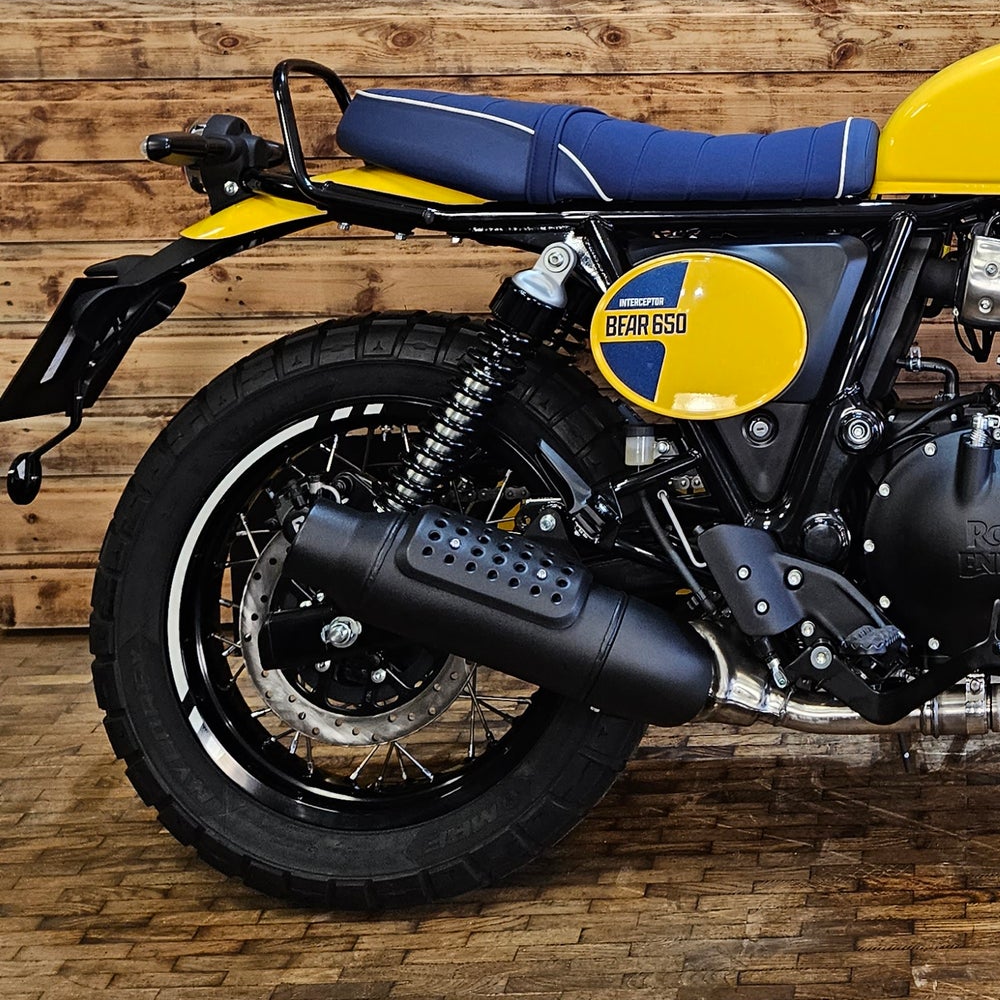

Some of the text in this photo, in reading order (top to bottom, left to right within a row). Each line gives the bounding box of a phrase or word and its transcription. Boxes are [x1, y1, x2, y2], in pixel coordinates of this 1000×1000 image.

[619, 297, 665, 307] INTERCEPTOR
[605, 313, 687, 337] BEAR 650
